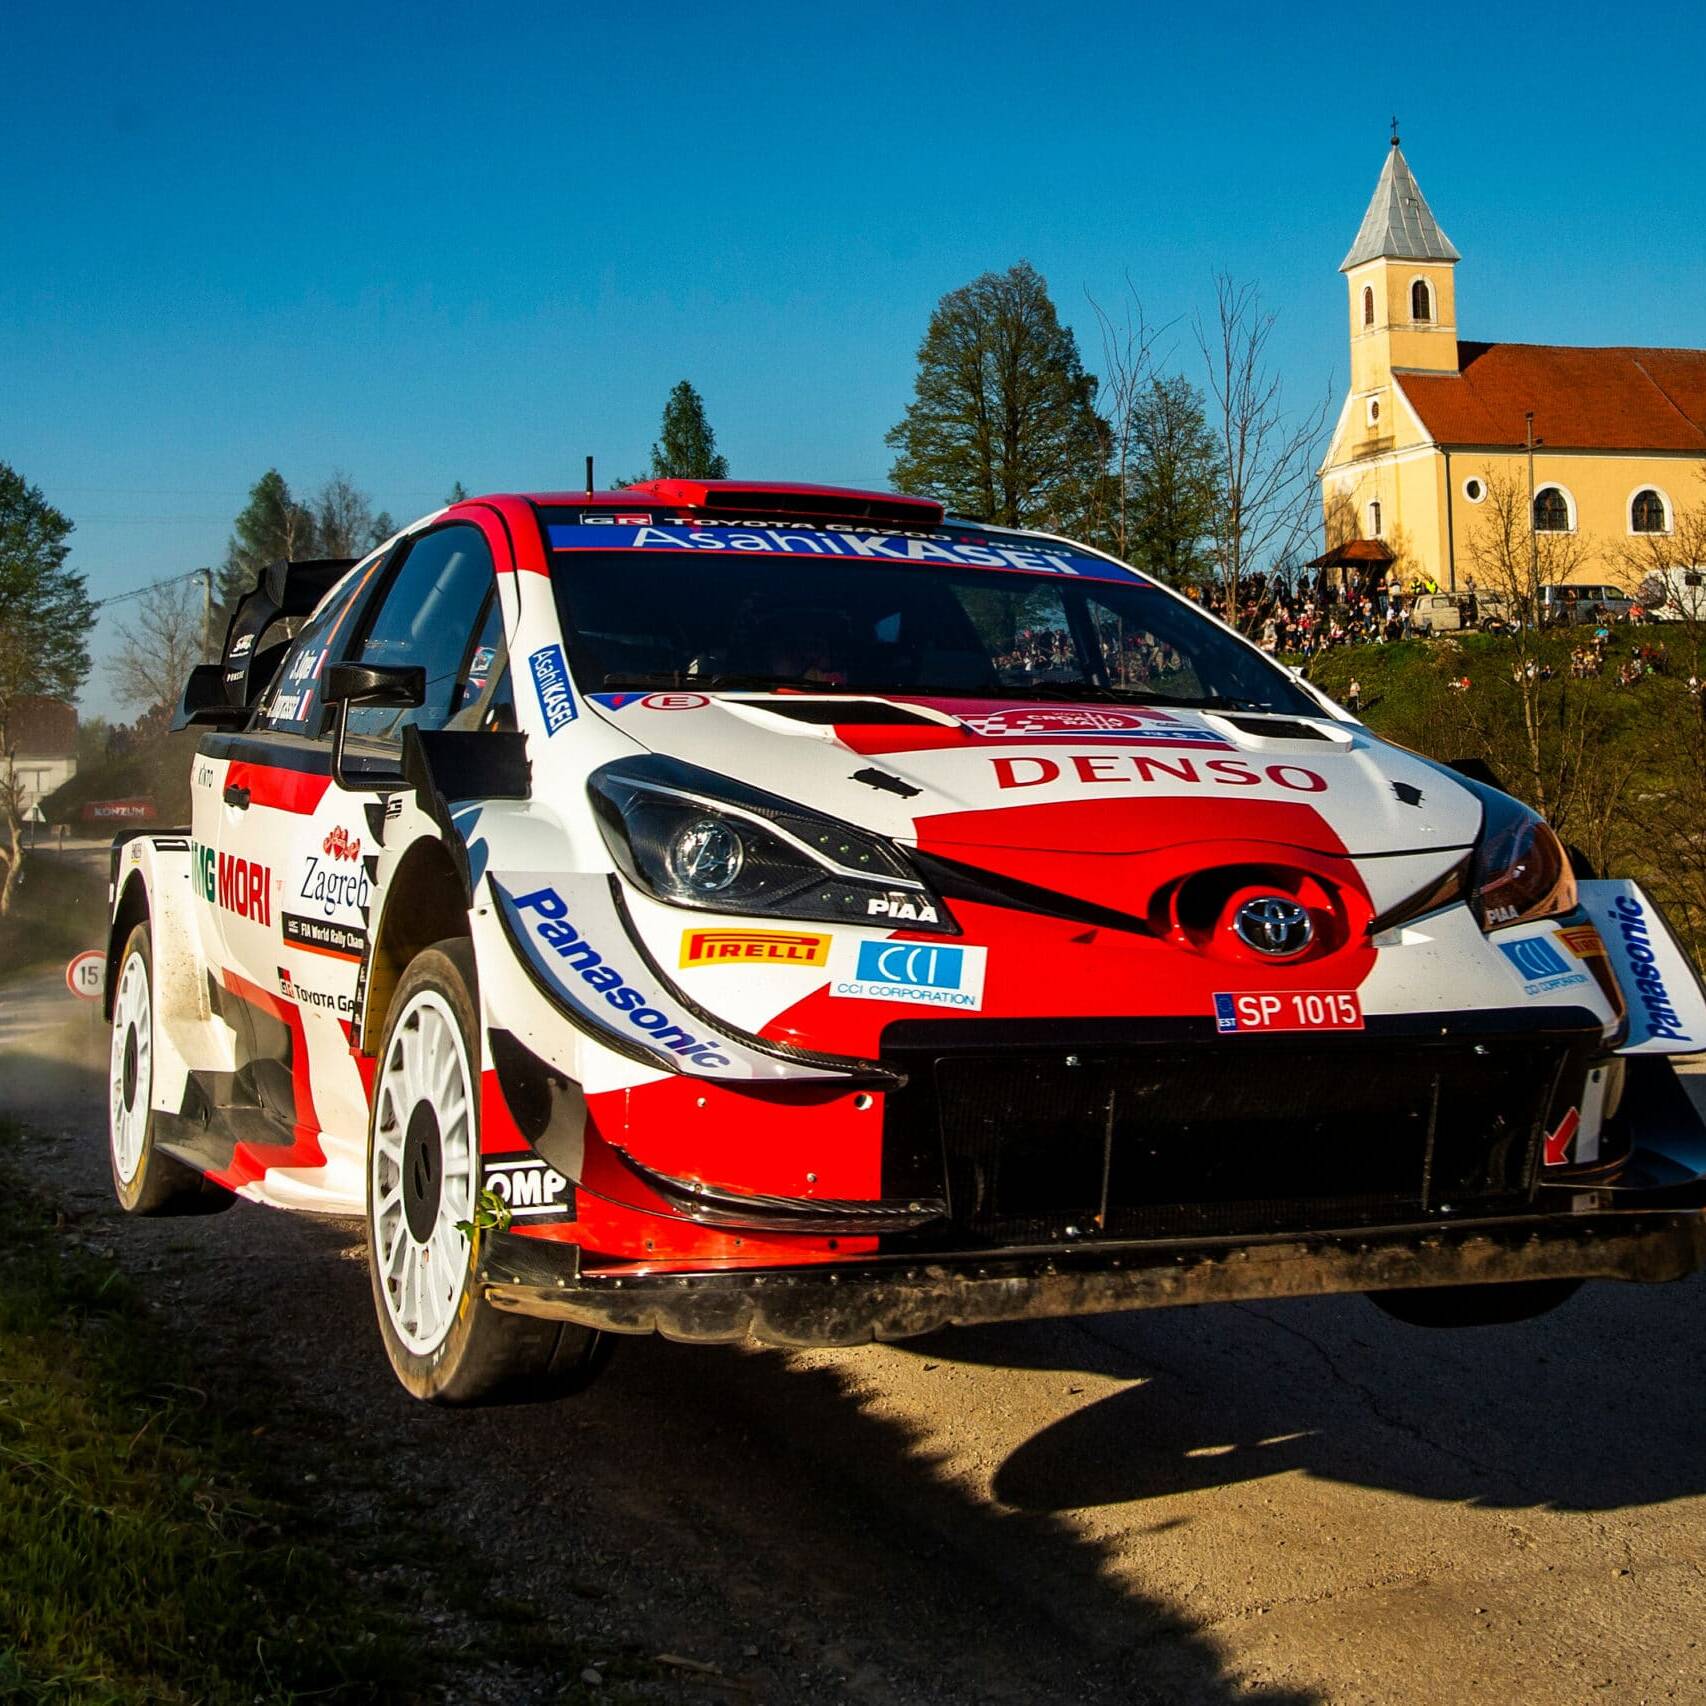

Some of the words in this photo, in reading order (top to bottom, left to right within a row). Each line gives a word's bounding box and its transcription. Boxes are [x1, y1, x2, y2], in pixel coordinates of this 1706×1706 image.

[584, 517, 649, 526] GR
[664, 518, 816, 530] TOYOTA
[825, 524, 952, 541] GAZOO
[632, 527, 1081, 575] AsahiKASEI
[532, 649, 573, 731] AsahiKASEI
[988, 756, 1328, 792] DENSO
[94, 806, 145, 817] KONZUM
[218, 851, 271, 927] MORI
[300, 856, 368, 916] Zagreb
[867, 898, 940, 923] PIAA
[1485, 904, 1520, 925] PIAA
[689, 933, 820, 961] PIRELLI
[81, 966, 98, 985] 15
[511, 887, 730, 1069] Panasonic
[877, 946, 938, 984] CCI
[1608, 895, 1693, 1042] Panasonic
[294, 984, 335, 1011] TOYOTA
[837, 983, 864, 995] CCI
[869, 985, 976, 1007] CORPORATION
[1238, 996, 1282, 1026] SP
[1292, 995, 1358, 1025] 1015
[1219, 1018, 1236, 1027] EST
[486, 1168, 567, 1206] OMP
